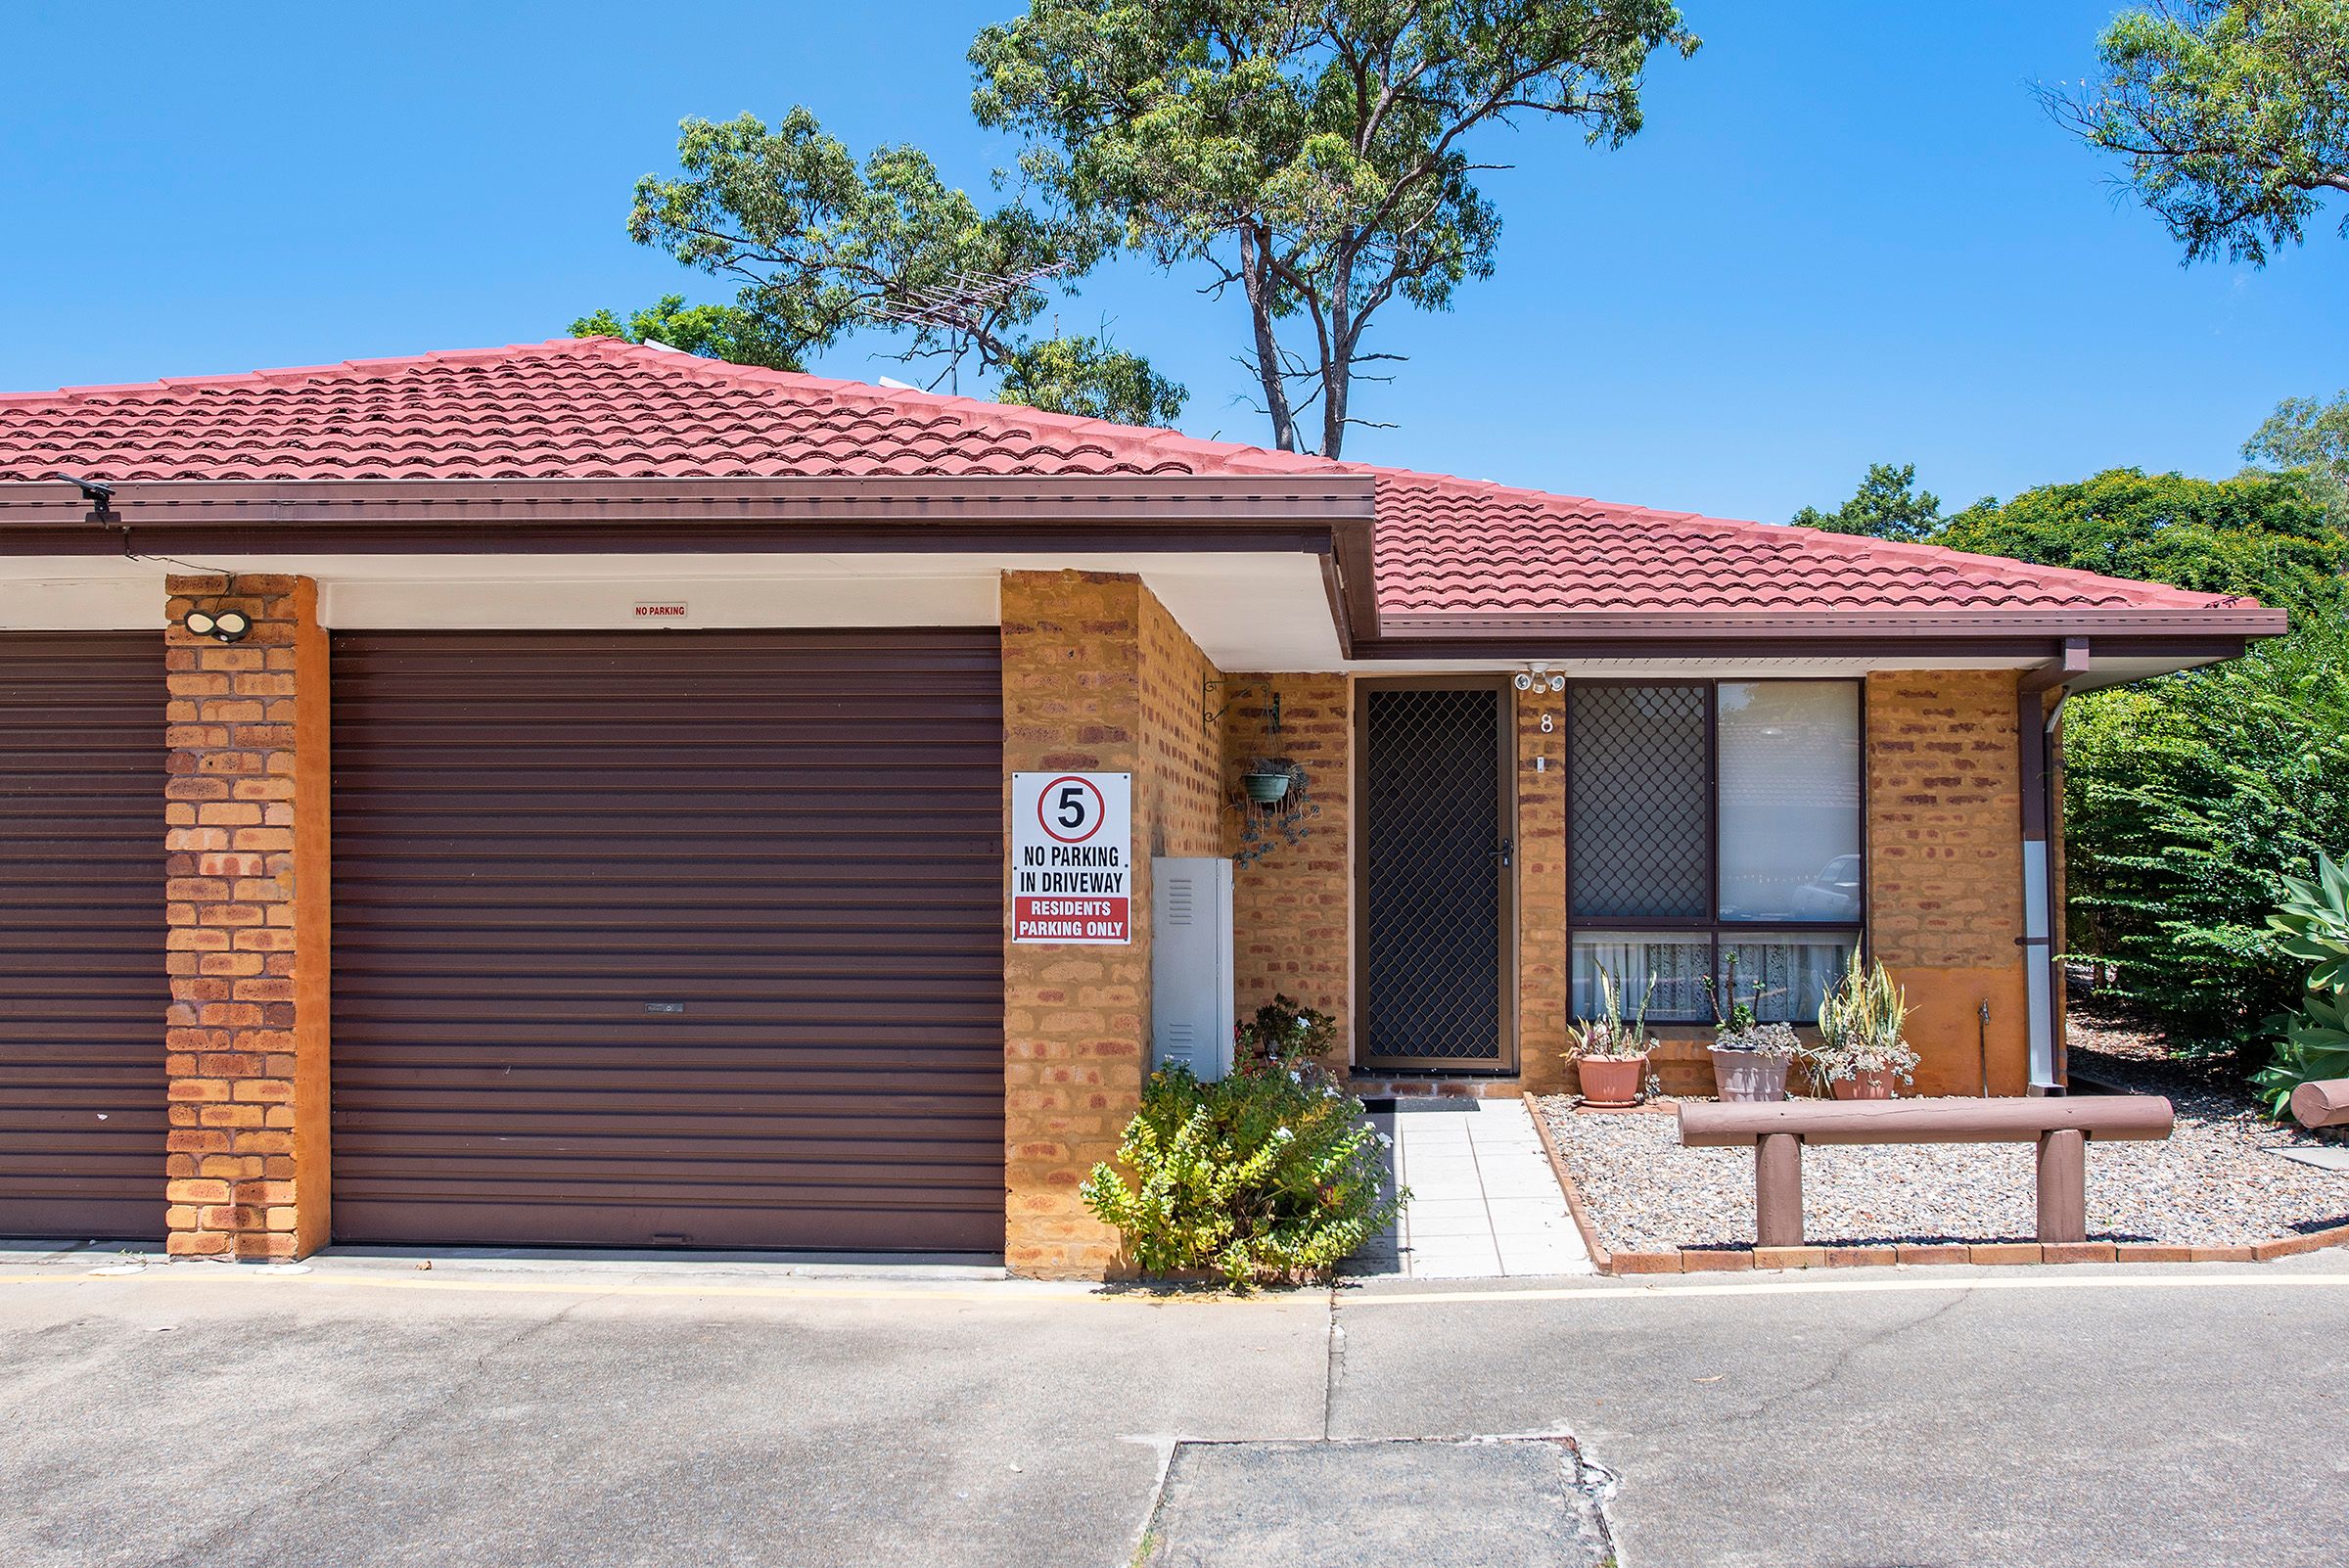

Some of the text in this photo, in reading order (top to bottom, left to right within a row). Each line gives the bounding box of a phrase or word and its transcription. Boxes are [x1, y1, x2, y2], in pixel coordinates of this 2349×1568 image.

[635, 606, 685, 616] NO PARKING
[1541, 714, 1553, 733] 8
[1057, 787, 1085, 828] 5
[1024, 846, 1119, 867] NO PARKING
[1020, 871, 1124, 894] IN DRIVEWAY
[1031, 900, 1112, 916] RESIDENTS
[1019, 921, 1124, 937] PARKING ONLY
